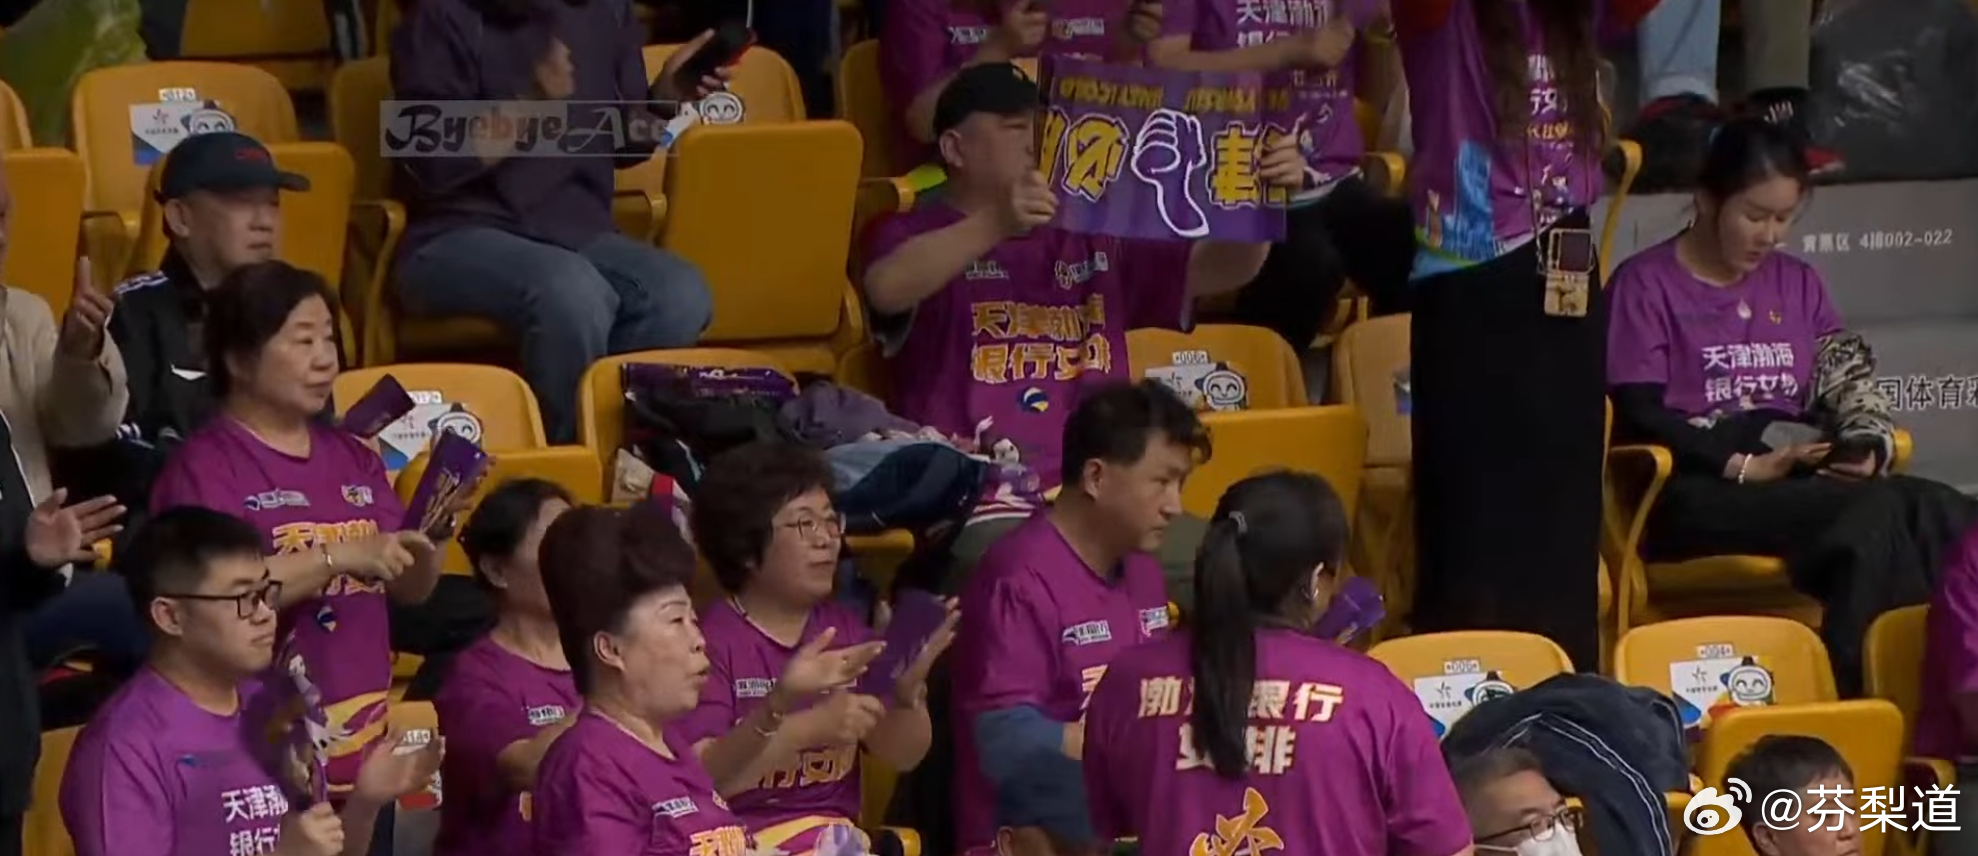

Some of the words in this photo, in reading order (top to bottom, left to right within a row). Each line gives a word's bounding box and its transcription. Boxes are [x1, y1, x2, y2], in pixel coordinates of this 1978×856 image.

[1701, 342, 1794, 371] 天津渤海
[1138, 676, 1343, 722] 渤银行
